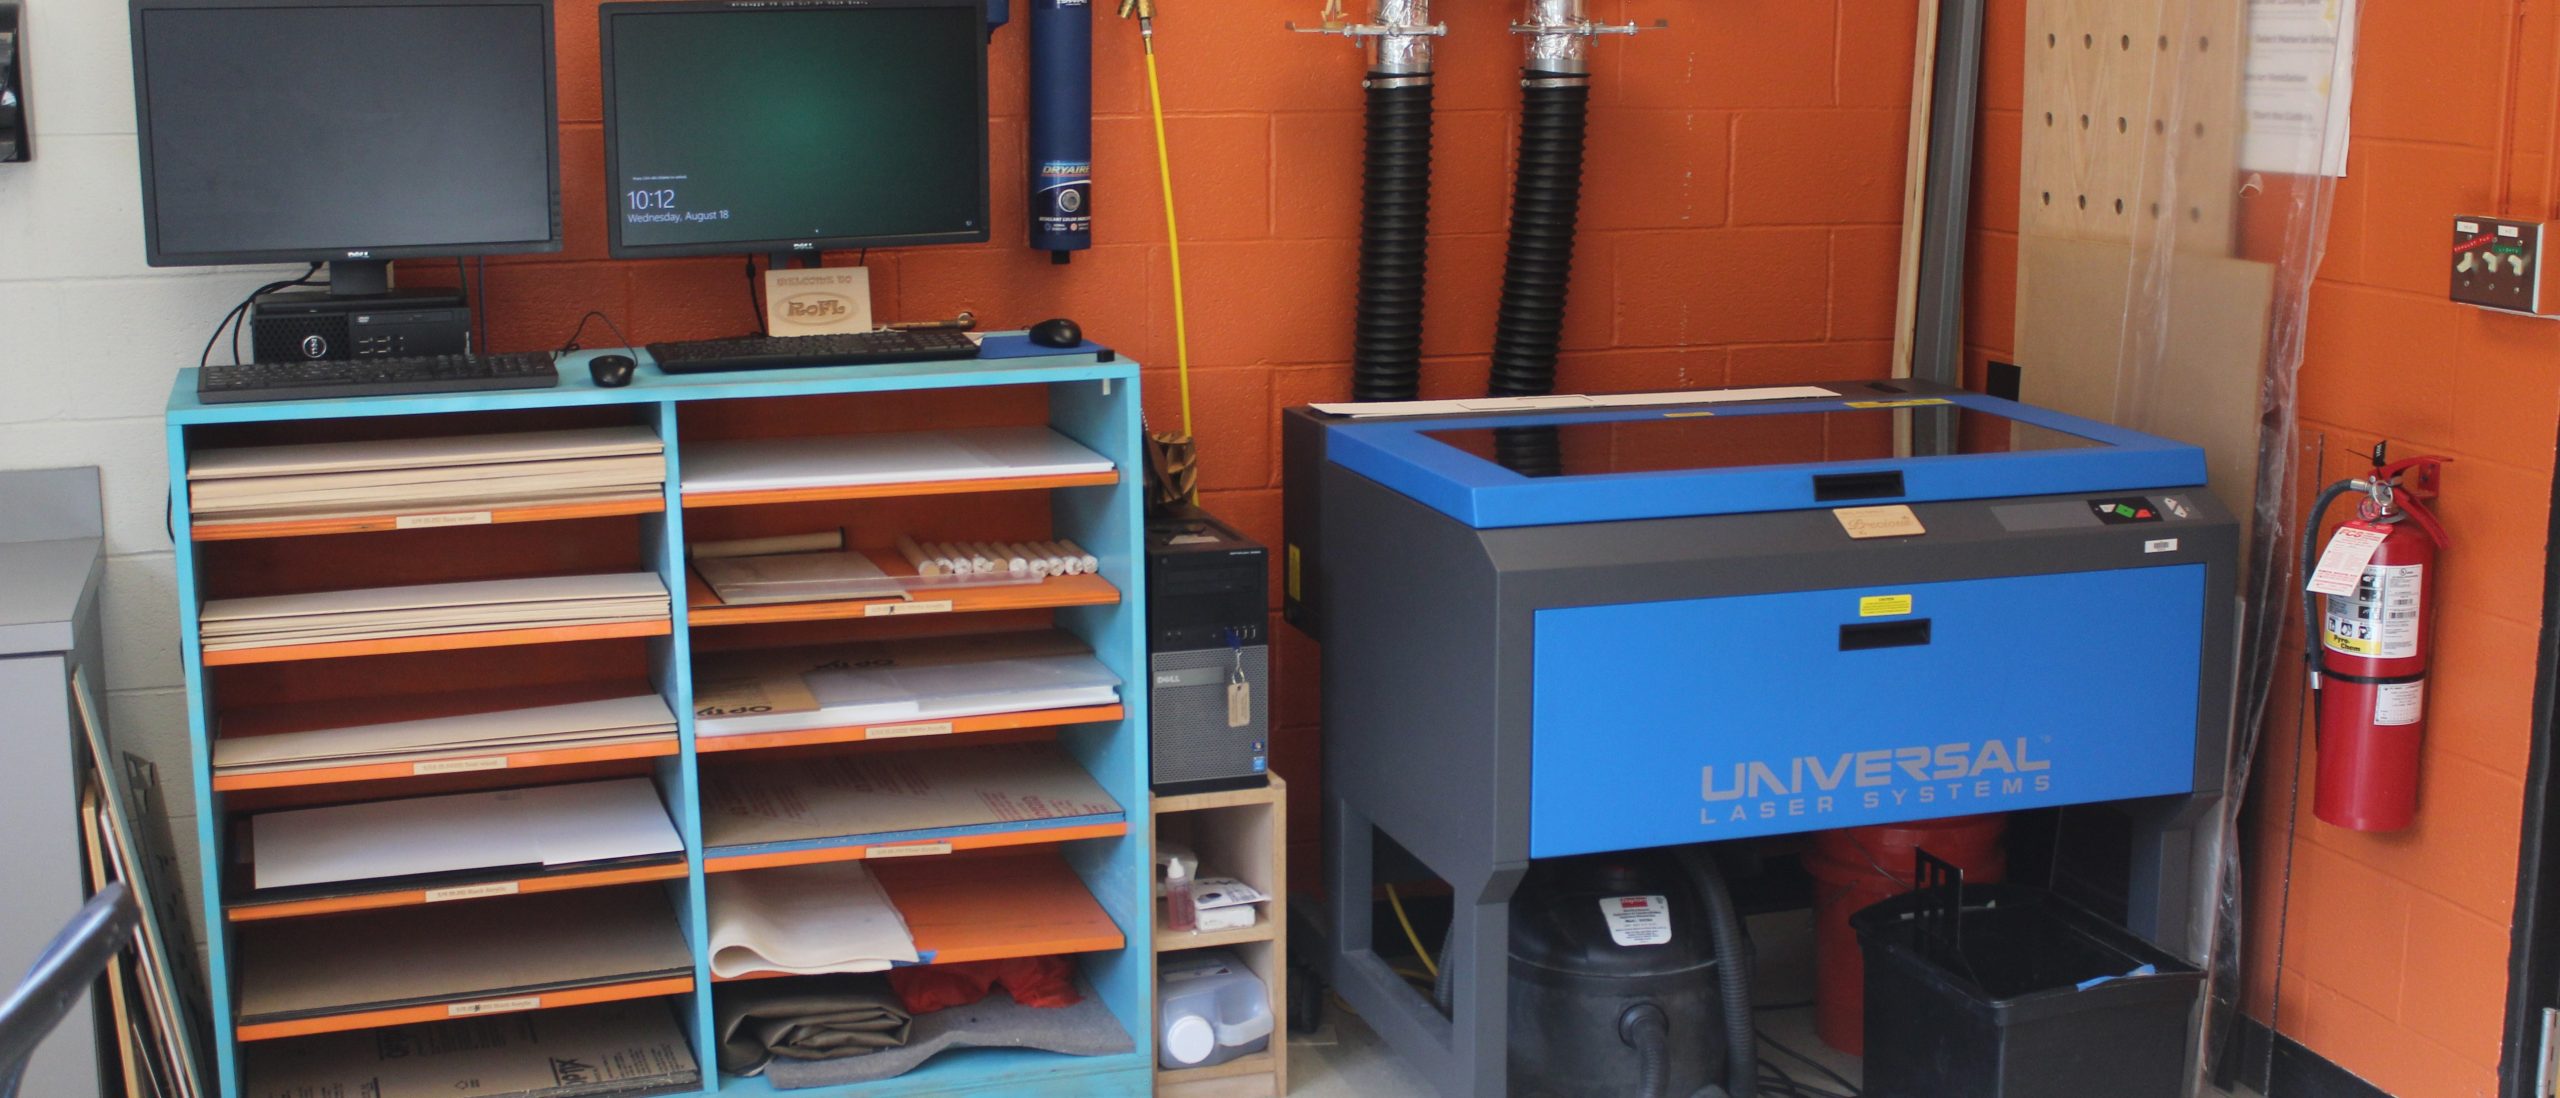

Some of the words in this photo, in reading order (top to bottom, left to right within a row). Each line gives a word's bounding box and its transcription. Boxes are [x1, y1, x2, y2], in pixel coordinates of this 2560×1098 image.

[627, 189, 675, 210] 10:12
[627, 212, 683, 224] Wednesday,
[685, 210, 717, 223] August
[719, 210, 729, 220] 18
[1156, 675, 1181, 684] DELL
[1702, 737, 2050, 801] UNIVERSAL
[1700, 791, 1834, 825] LASER
[1863, 774, 2051, 808] SYSTEMS
